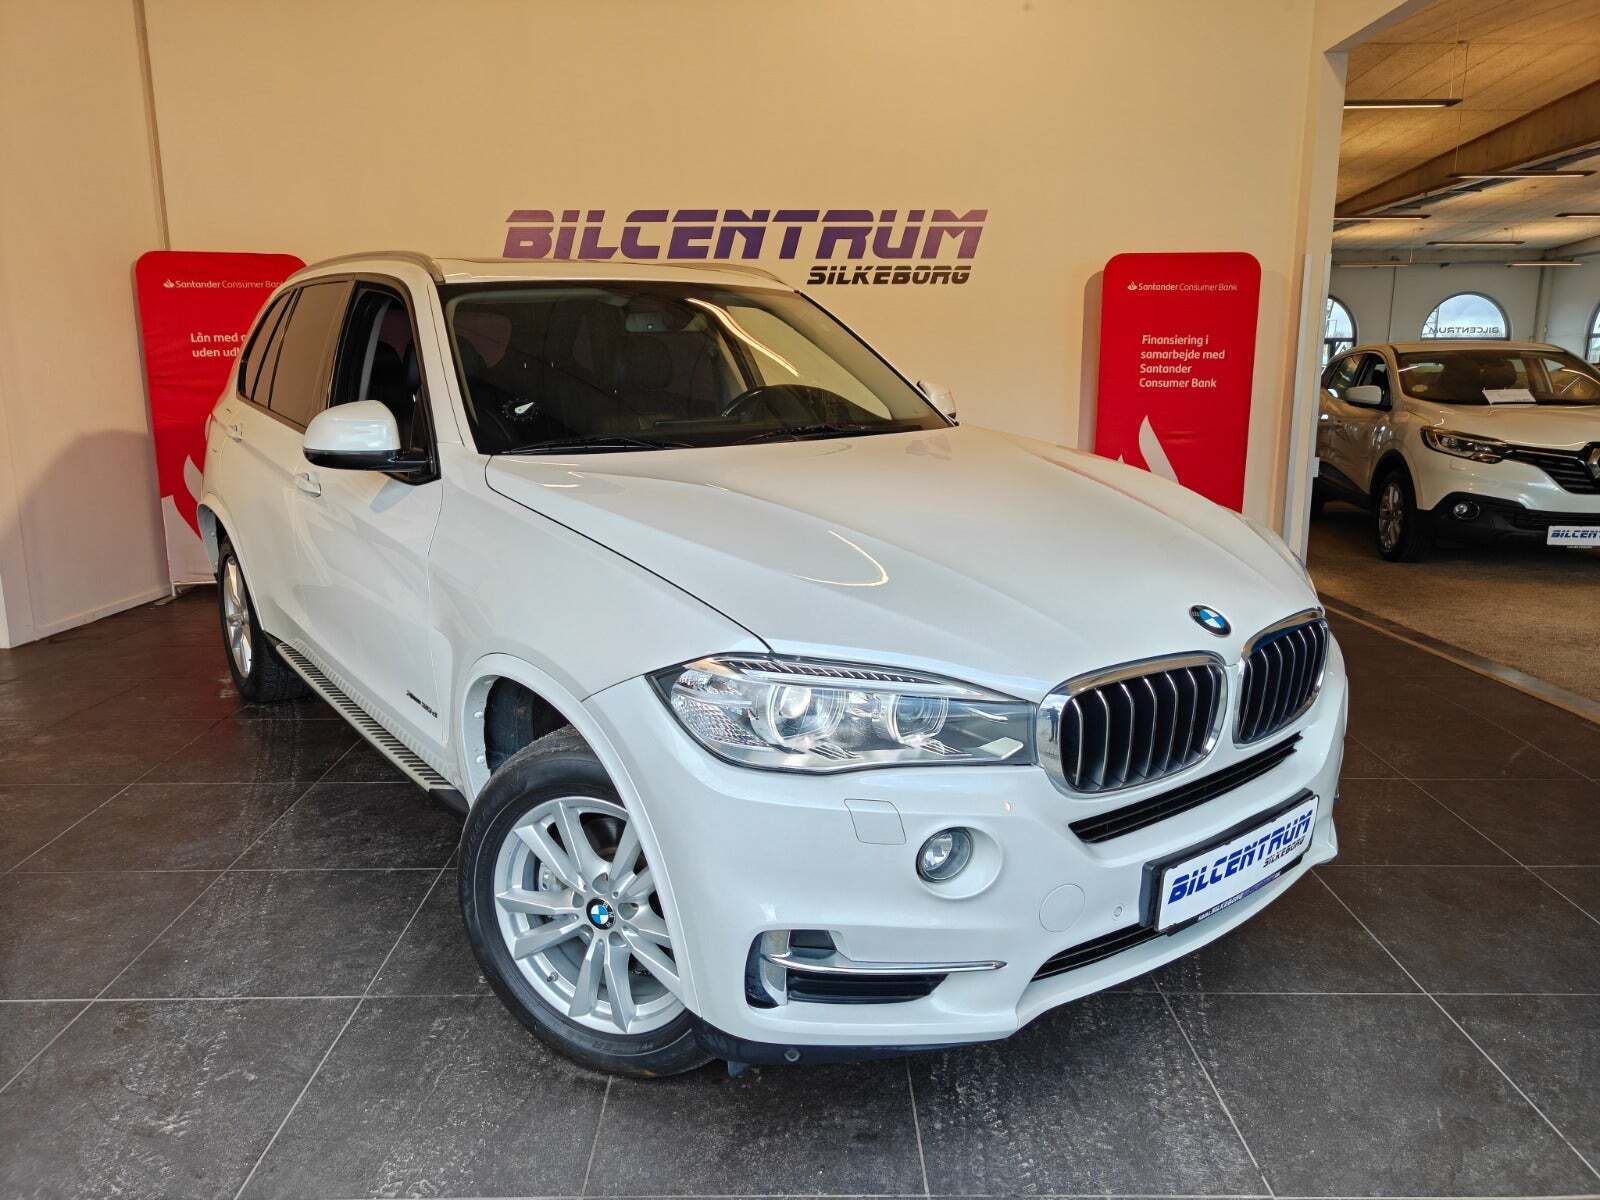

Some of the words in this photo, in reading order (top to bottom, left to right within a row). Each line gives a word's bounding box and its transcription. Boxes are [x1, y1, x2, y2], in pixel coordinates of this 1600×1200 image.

[502, 209, 988, 259] BILCENTRUM
[806, 265, 972, 285] SILKEBORG
[175, 280, 221, 289] Santander
[222, 280, 263, 289] Consumer
[265, 280, 284, 289] Ban
[1138, 282, 1178, 291] Santander
[1179, 282, 1217, 291] Consumer
[1218, 282, 1238, 291] Bank
[190, 332, 211, 343] Lån
[213, 332, 239, 343] med
[1141, 334, 1204, 347] Finansiering
[1205, 334, 1209, 345] i
[192, 347, 220, 357] uden
[1140, 349, 1201, 361] samarbejde
[1202, 349, 1226, 359] med
[1139, 363, 1192, 374] Santander
[1139, 377, 1189, 388] Consumer
[1191, 377, 1217, 388] Bank
[1551, 529, 1600, 539] BILCEN
[1167, 809, 1313, 905] BILCENTRUM
[1263, 835, 1305, 868] SILKEBORG
